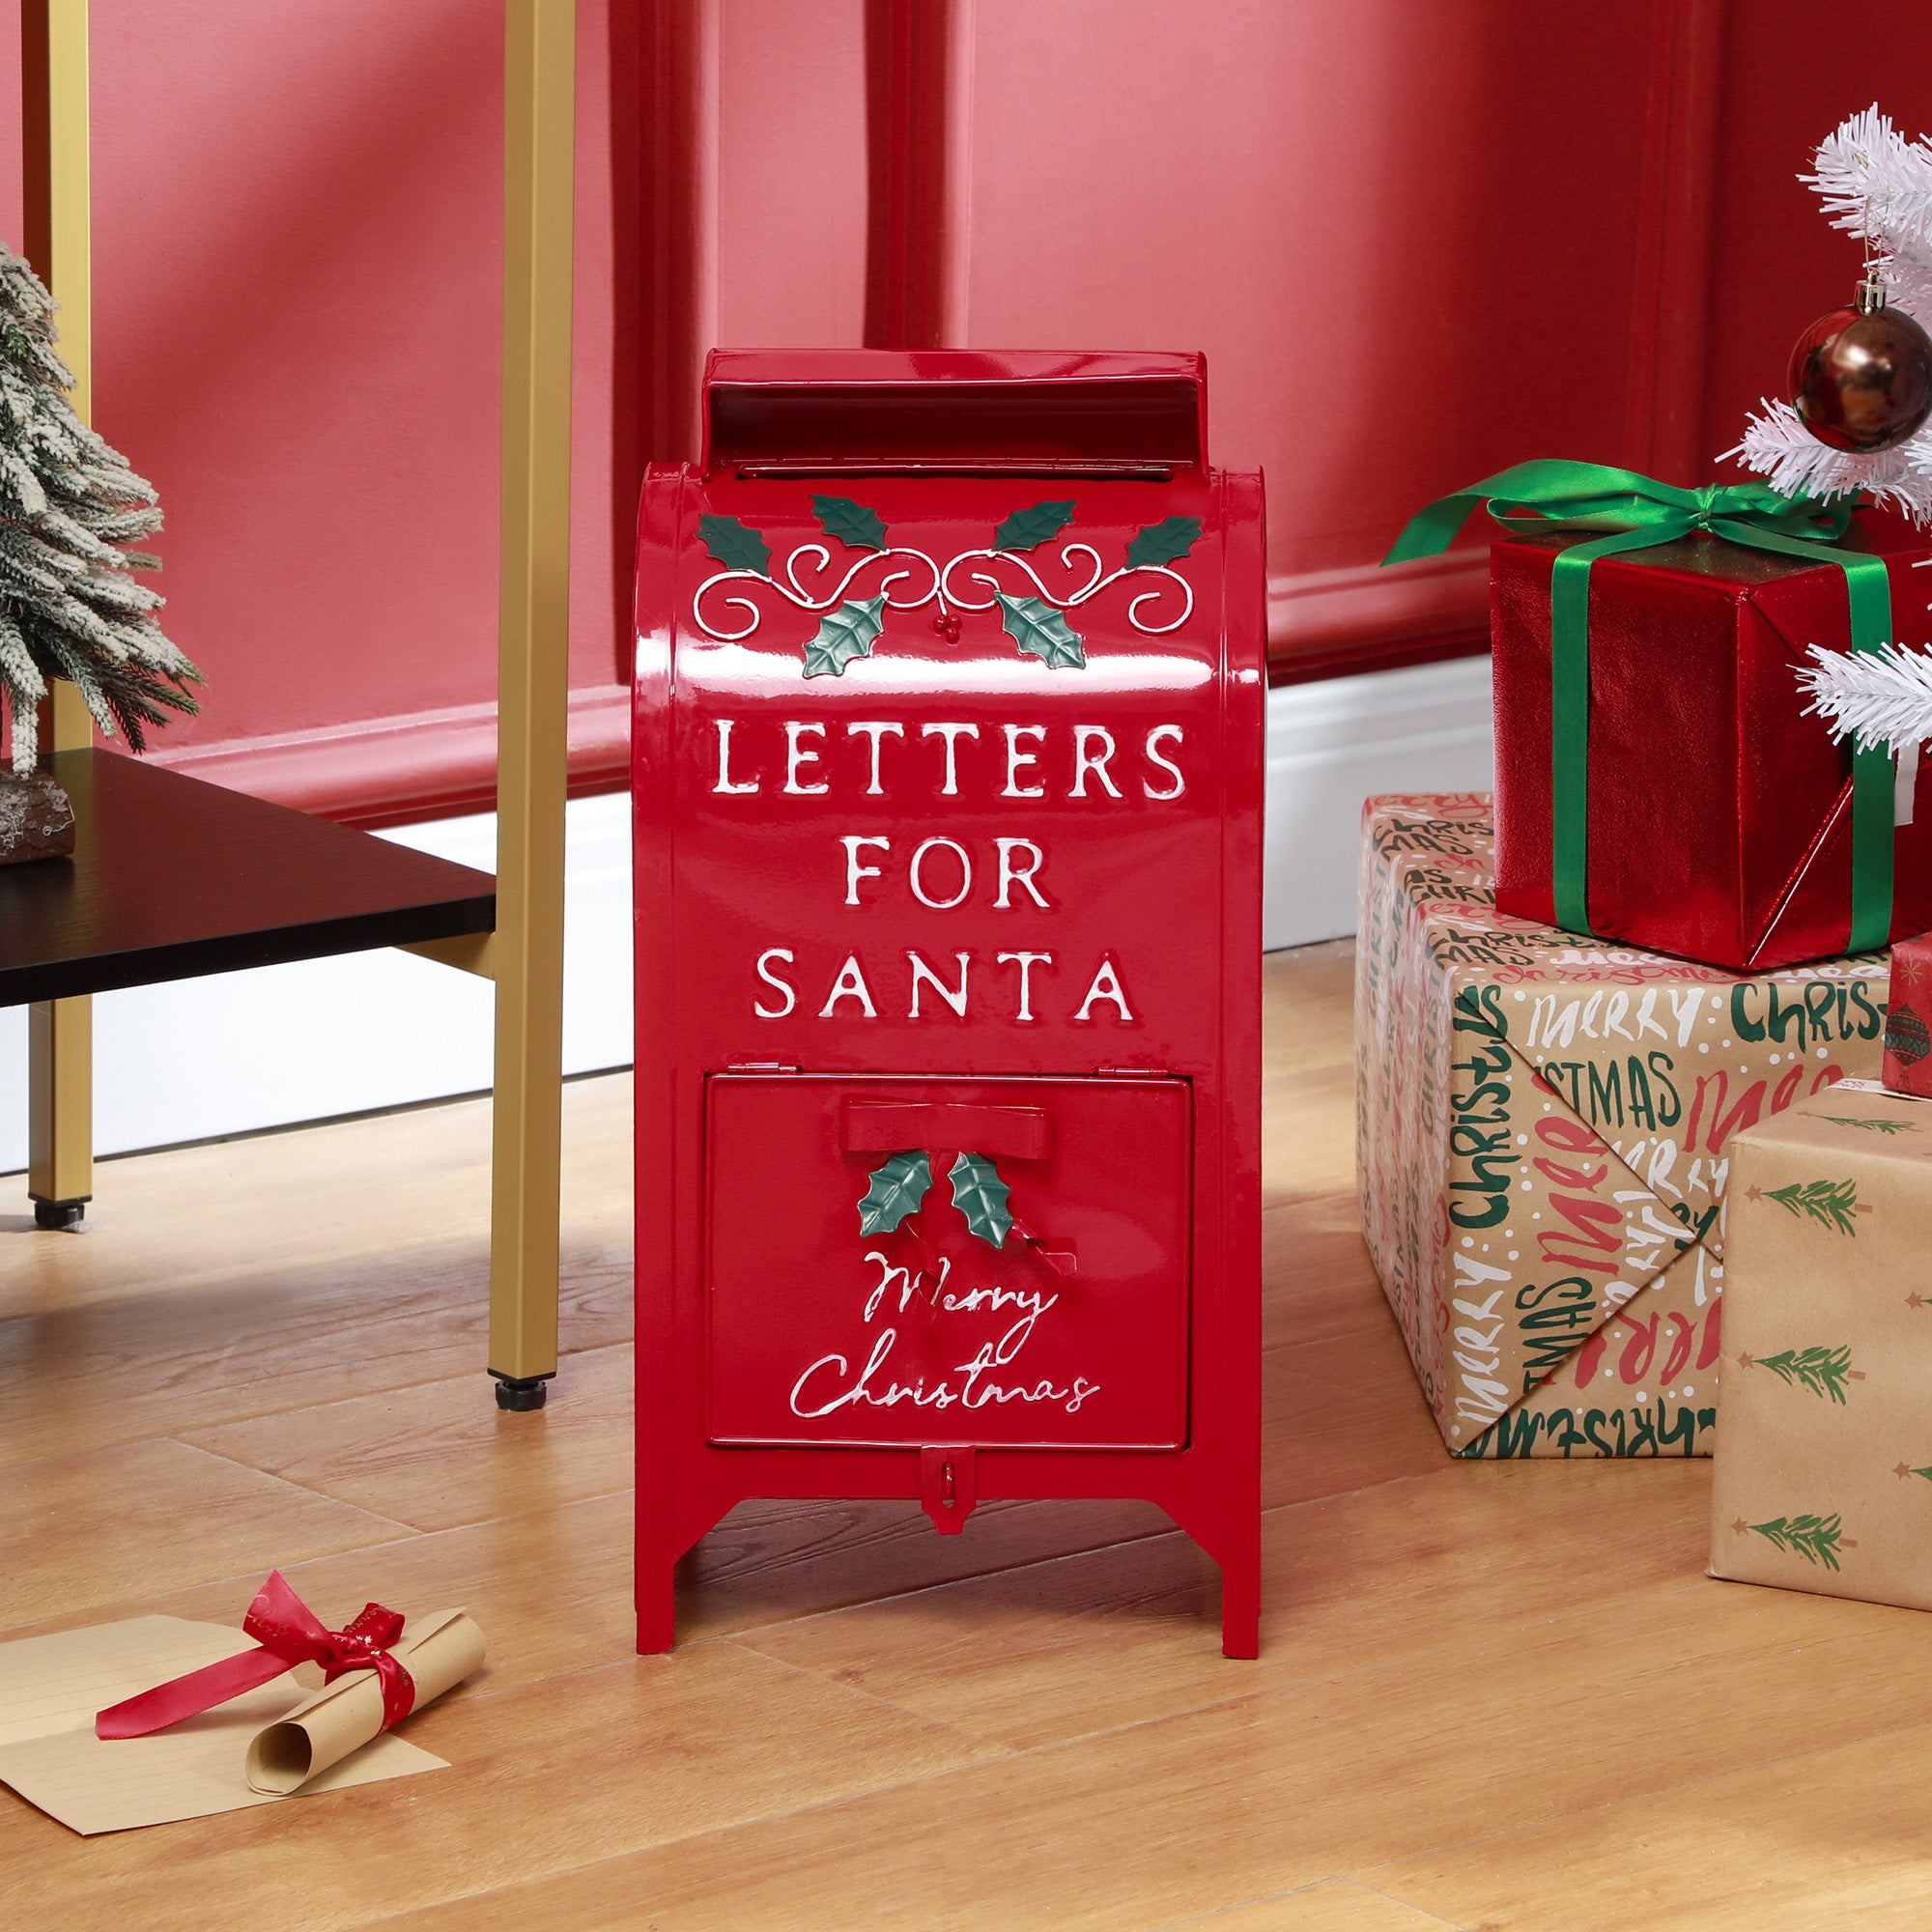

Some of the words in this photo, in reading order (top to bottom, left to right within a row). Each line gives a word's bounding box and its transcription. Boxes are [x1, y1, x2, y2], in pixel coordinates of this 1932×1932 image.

[712, 720, 1186, 801] LETTERS
[839, 837, 1051, 909] FOR
[754, 949, 1134, 1021] SANTA
[864, 1251, 1059, 1365] Merry
[790, 1327, 1101, 1418] Christmas
